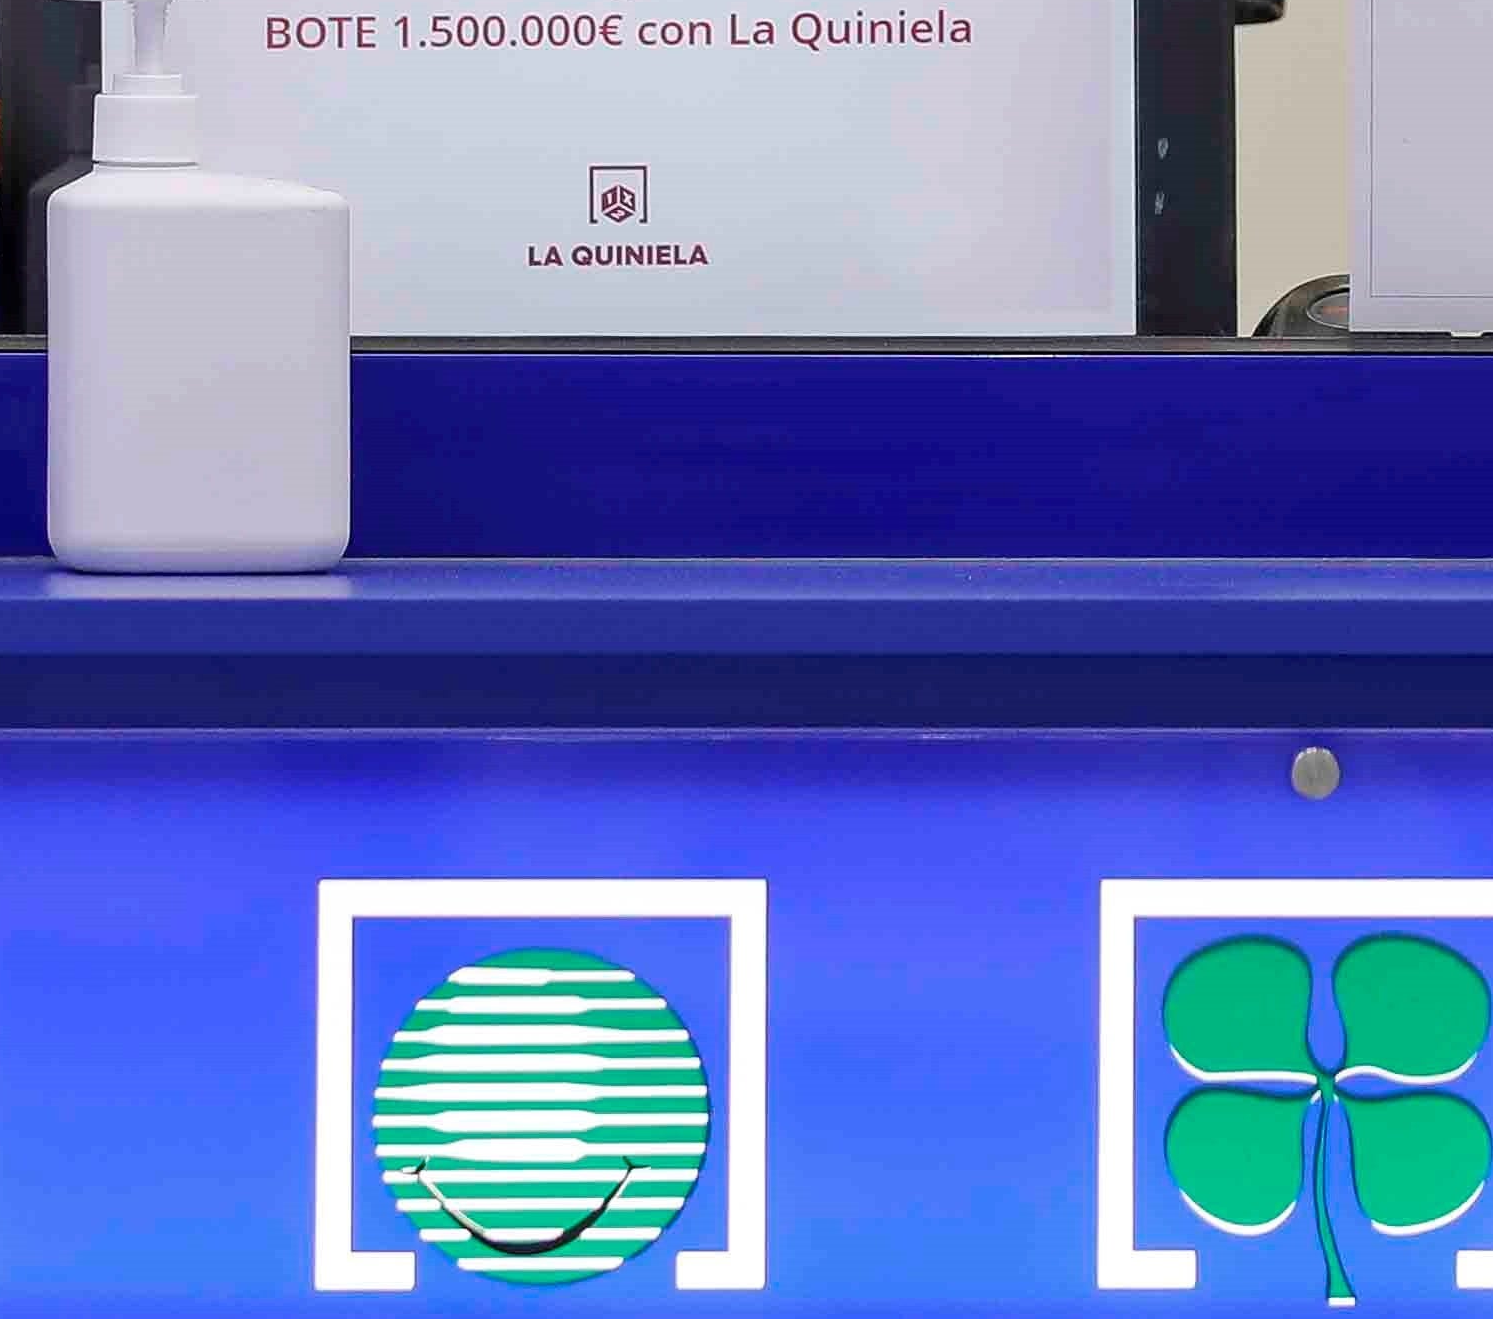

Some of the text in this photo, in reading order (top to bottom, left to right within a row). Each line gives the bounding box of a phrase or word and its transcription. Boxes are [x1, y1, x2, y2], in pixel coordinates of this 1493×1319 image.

[266, 9, 972, 52] BOTE 1.500.000€ con La Quiniela
[528, 244, 709, 267] LA QUINIELA
